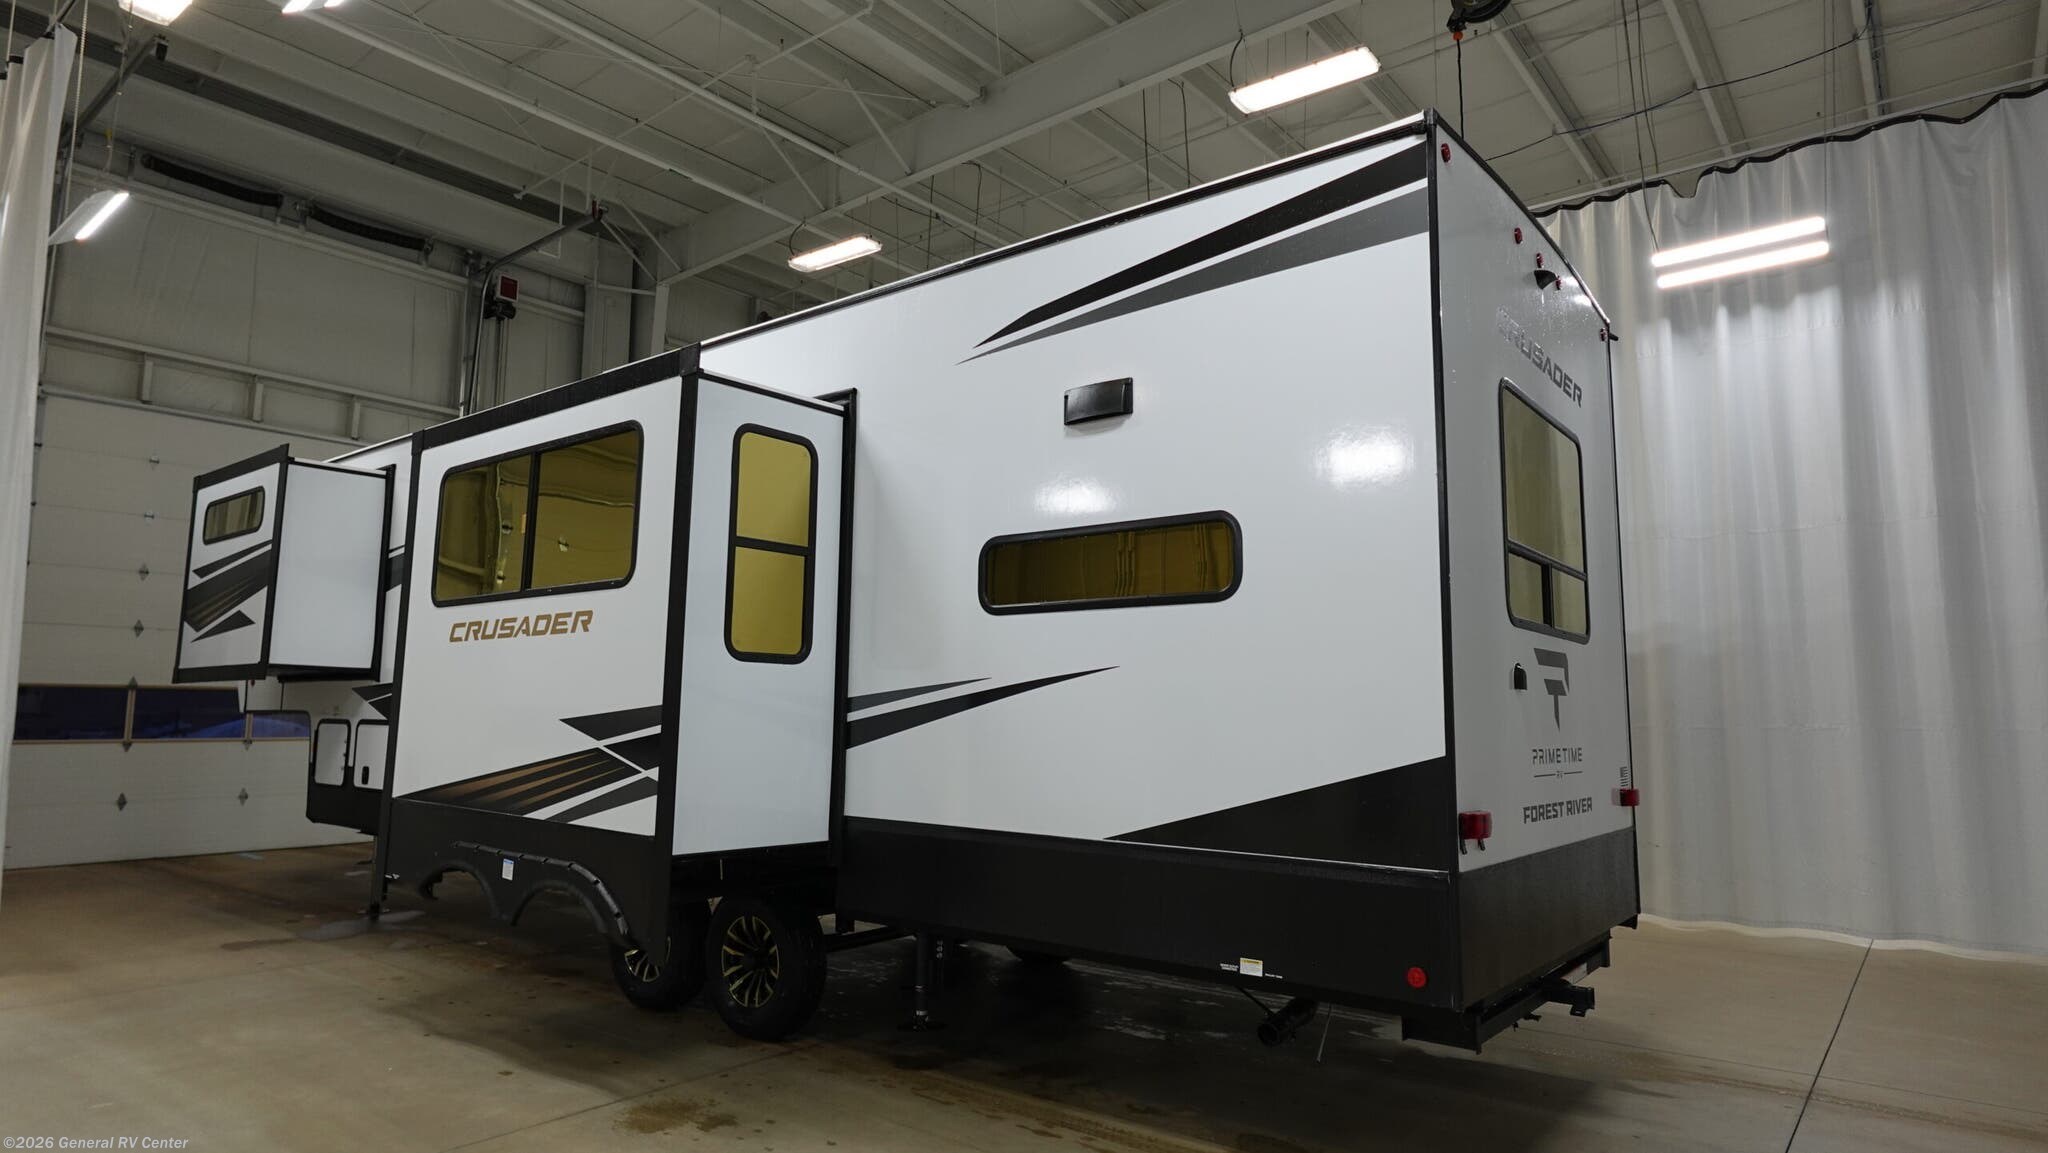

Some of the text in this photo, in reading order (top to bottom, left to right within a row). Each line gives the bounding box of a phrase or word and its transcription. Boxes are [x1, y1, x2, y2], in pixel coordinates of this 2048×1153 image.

[1497, 308, 1582, 408] RUSADER
[449, 609, 594, 643] CRUSADER
[1522, 796, 1593, 825] FOREST RIVER
